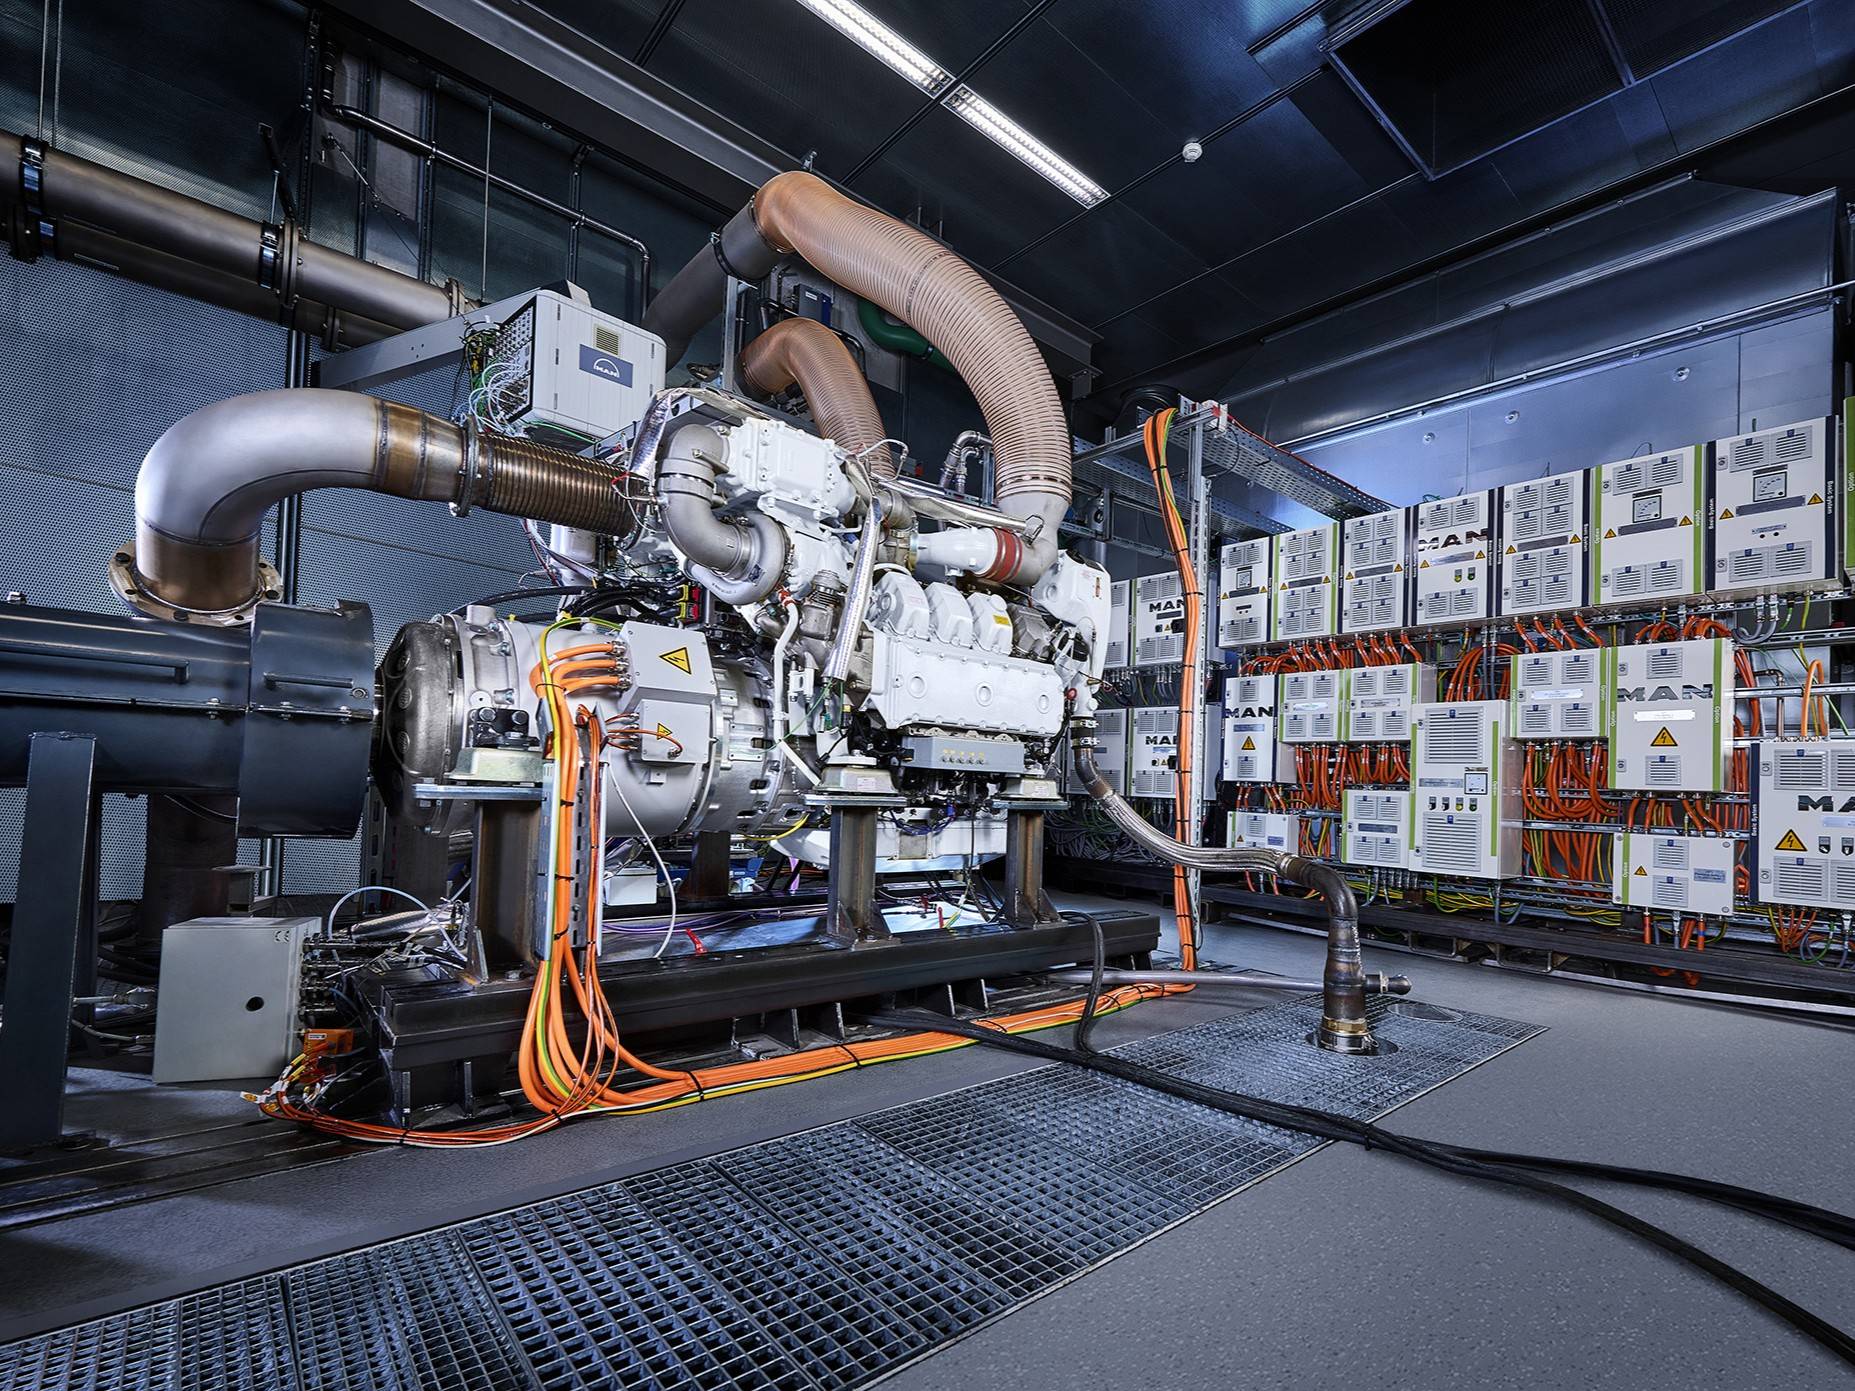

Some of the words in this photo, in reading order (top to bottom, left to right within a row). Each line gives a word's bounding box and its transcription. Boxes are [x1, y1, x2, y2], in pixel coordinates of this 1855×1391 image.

[596, 366, 618, 377] MAN
[1826, 480, 1834, 496] Basic
[1418, 527, 1488, 552] MAN
[1616, 684, 1713, 702] MAN
[1225, 705, 1273, 718] MAN
